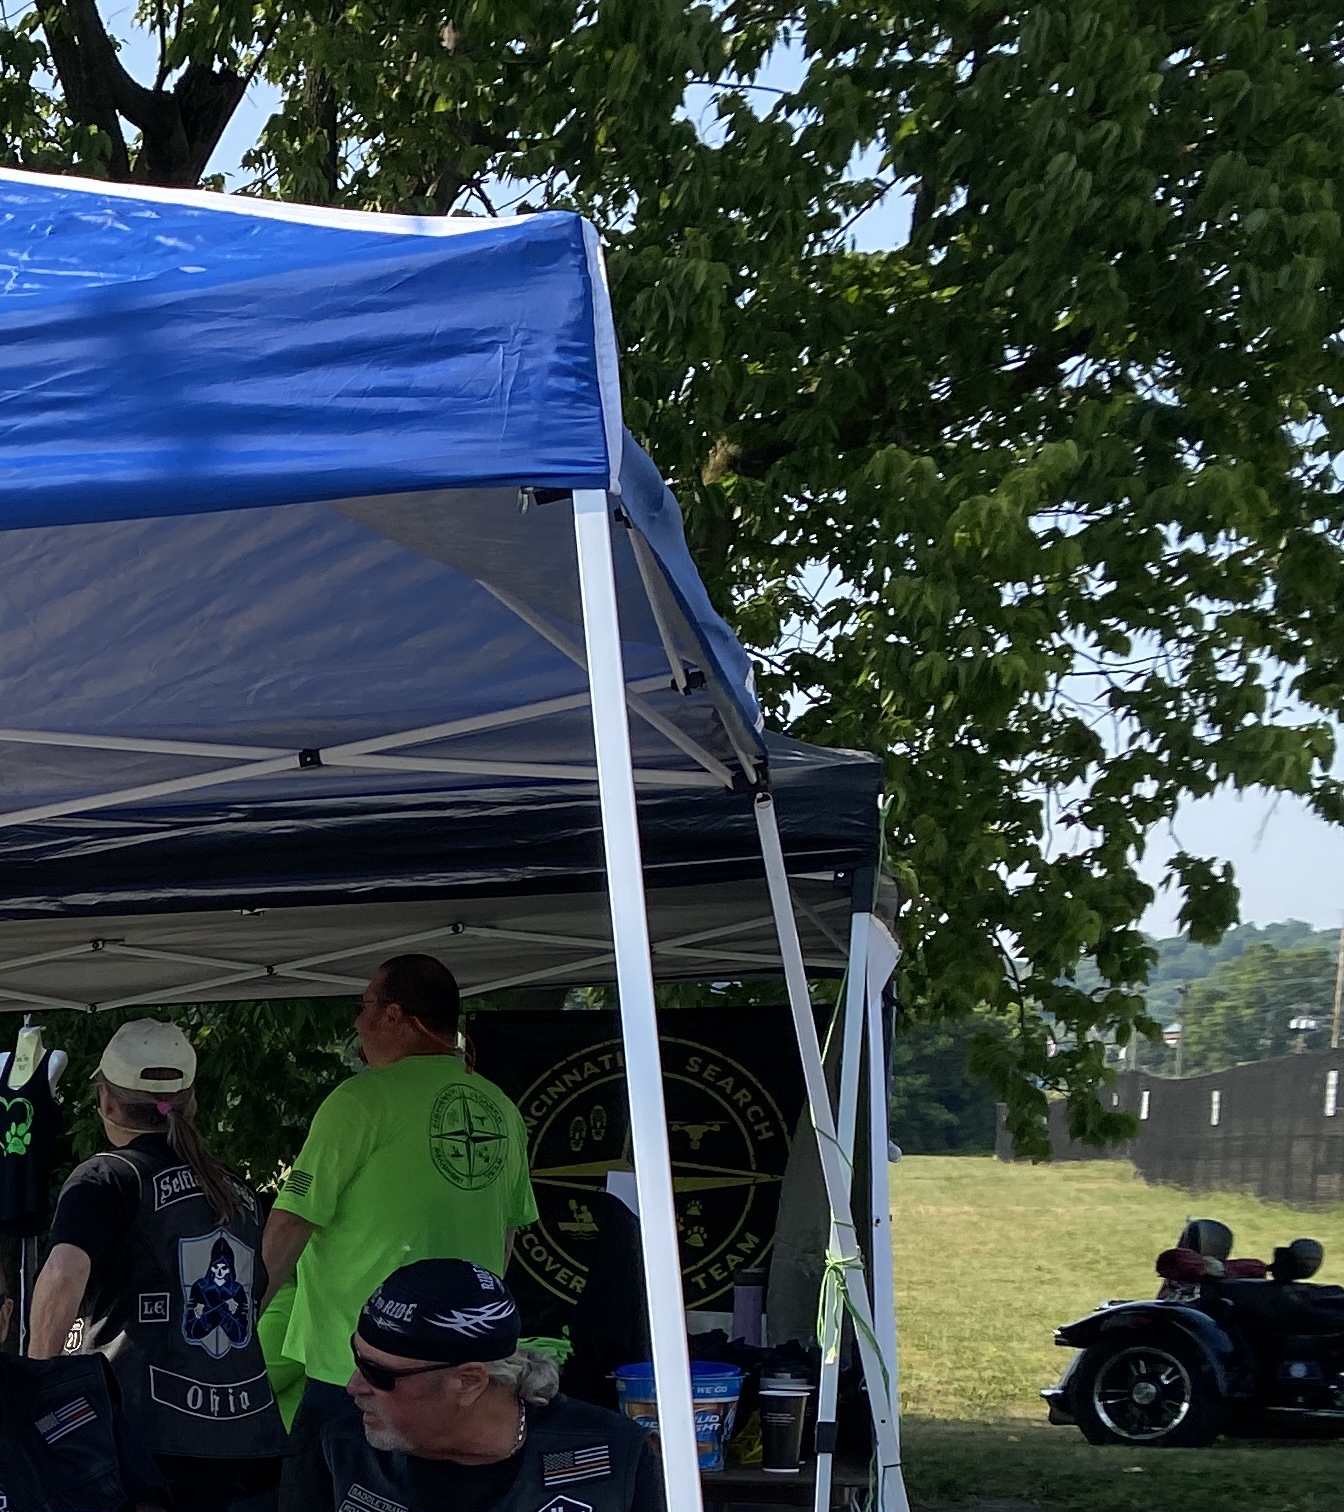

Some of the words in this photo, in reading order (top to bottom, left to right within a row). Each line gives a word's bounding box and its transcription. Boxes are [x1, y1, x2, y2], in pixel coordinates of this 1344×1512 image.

[524, 1051, 625, 1138] NCINNATI
[685, 1056, 775, 1141] SEARCH
[691, 1232, 760, 1290] TEAM
[143, 1300, 166, 1316] LE
[381, 1302, 418, 1323] RIDE
[186, 1385, 251, 1416] Ohio
[352, 1487, 380, 1508] SADDLE
